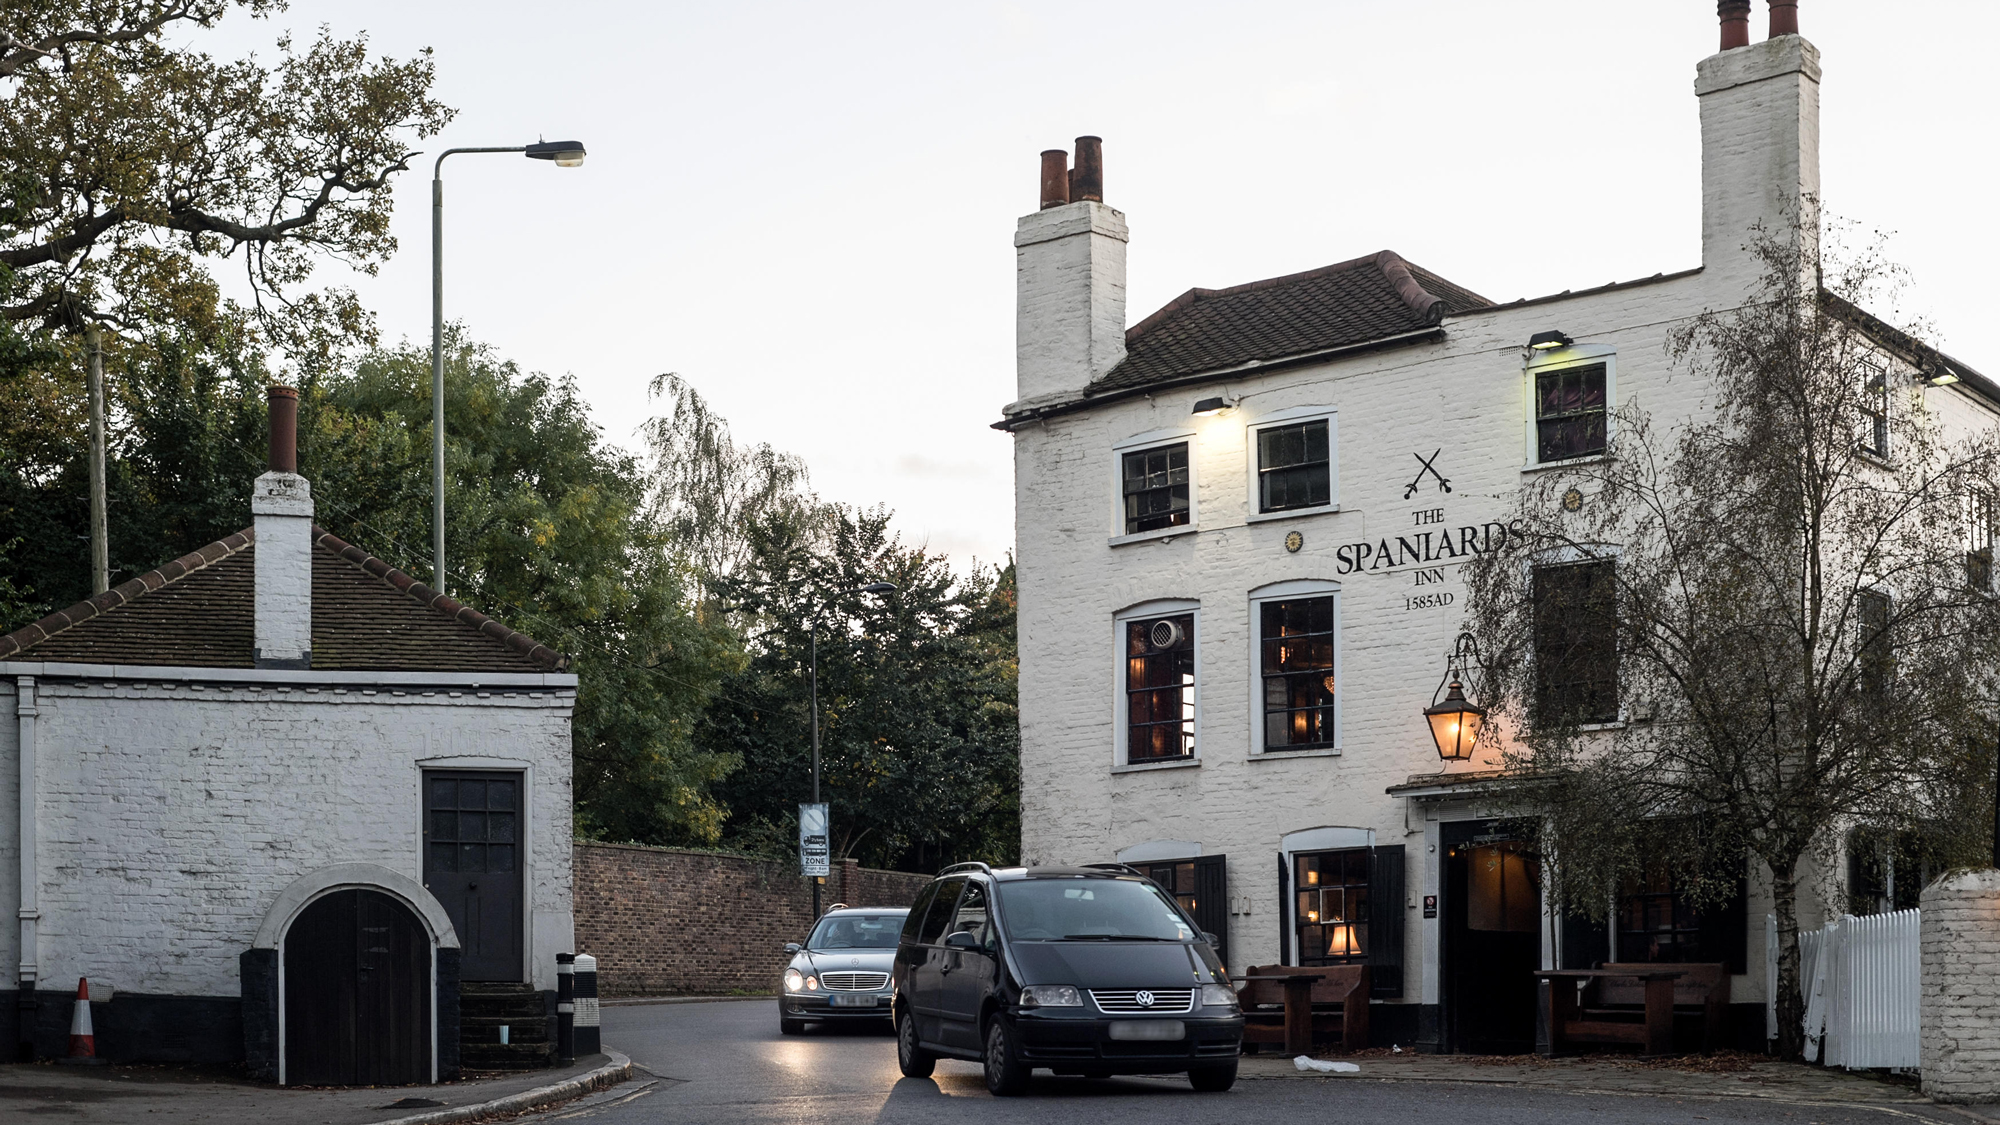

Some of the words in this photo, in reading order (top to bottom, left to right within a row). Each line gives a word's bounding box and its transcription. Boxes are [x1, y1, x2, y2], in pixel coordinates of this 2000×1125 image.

[1412, 508, 1445, 526] THE
[1336, 518, 1525, 576] SPANIARDS
[1414, 568, 1445, 586] INN
[1405, 592, 1454, 611] 1585AD
